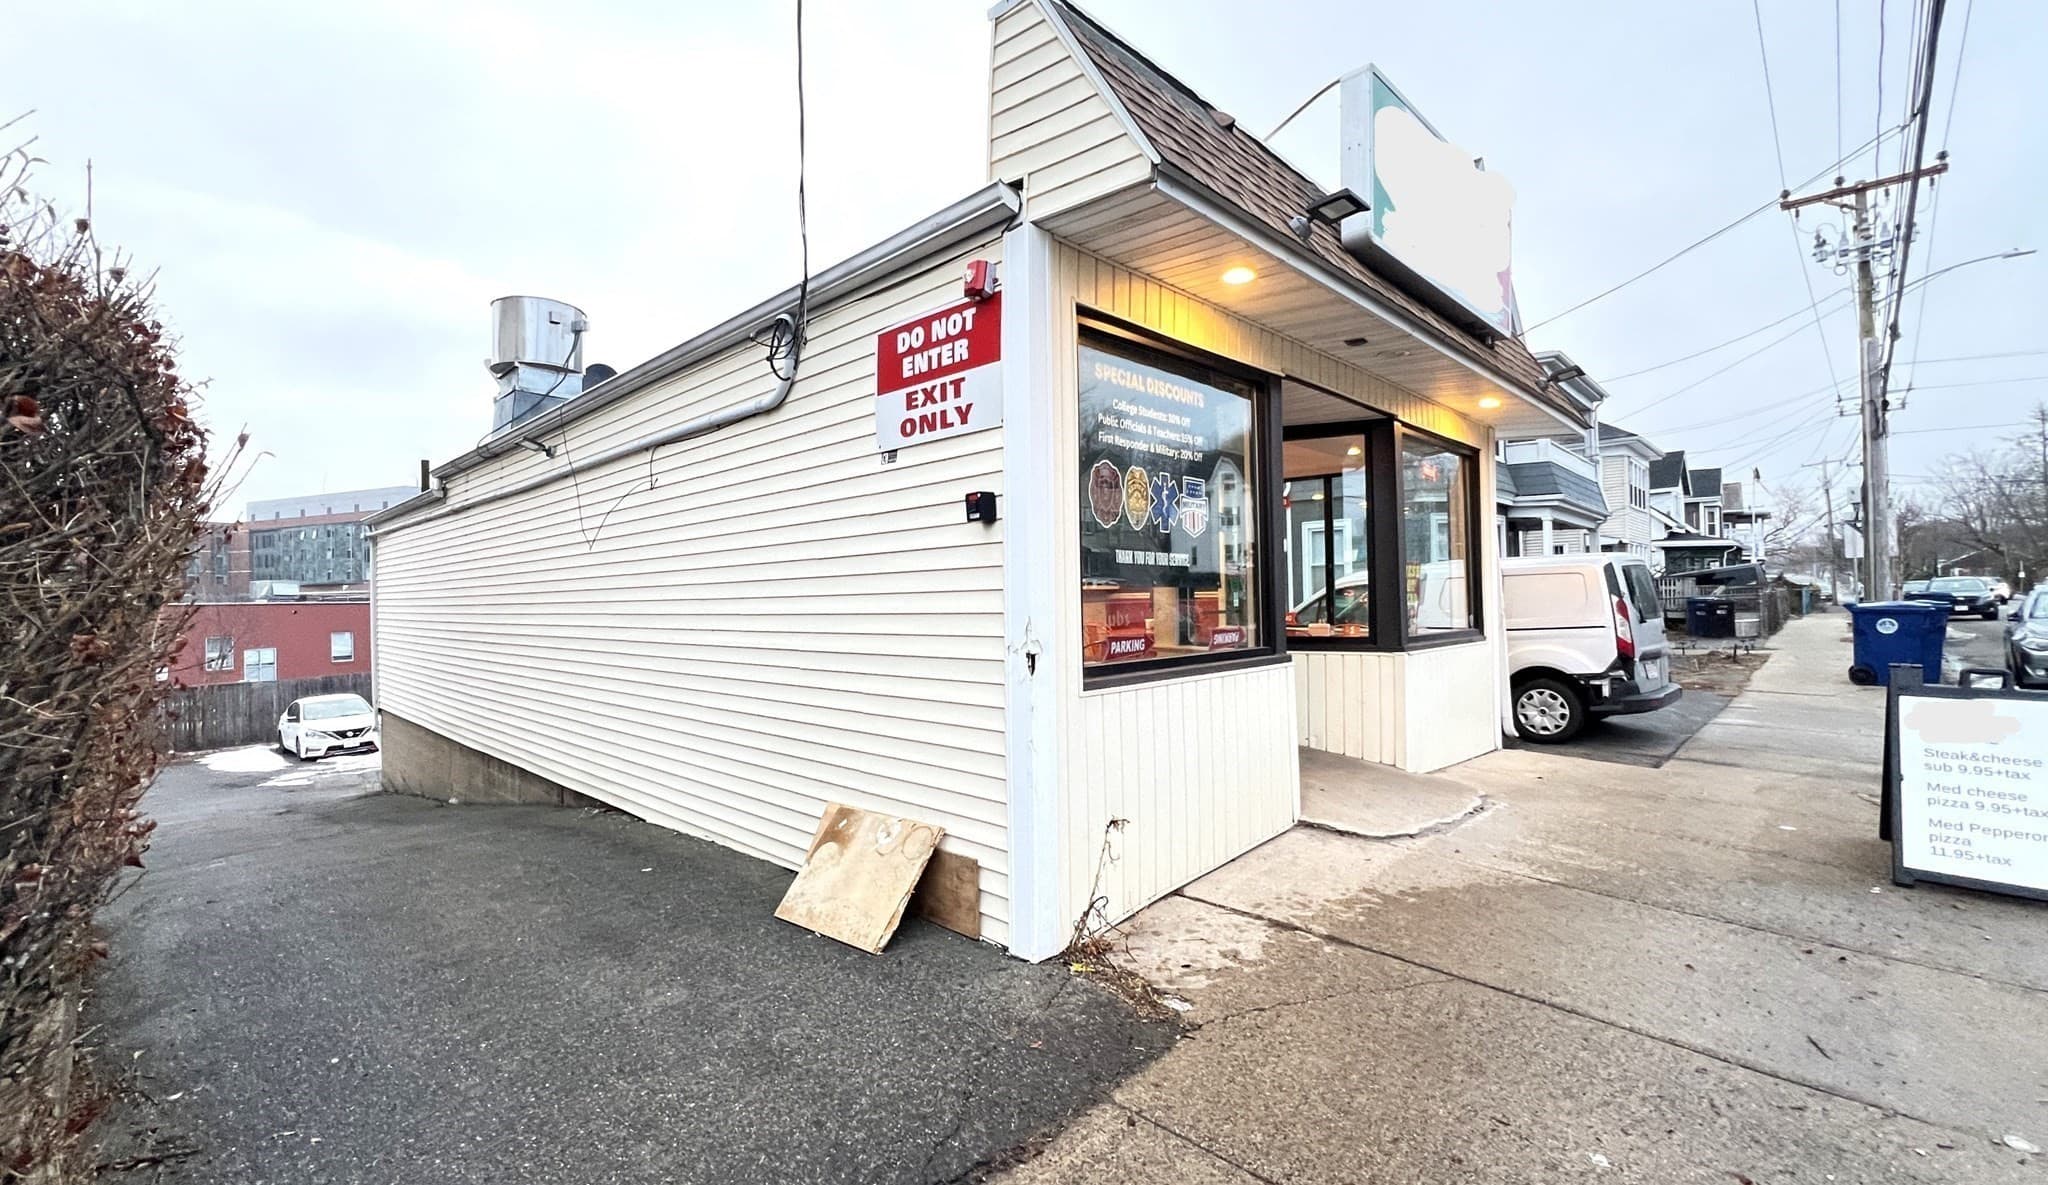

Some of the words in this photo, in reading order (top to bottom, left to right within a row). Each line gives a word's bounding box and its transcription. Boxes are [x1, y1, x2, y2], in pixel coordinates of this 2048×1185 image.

[897, 326, 925, 354] DO
[931, 306, 977, 342] NOT
[902, 338, 969, 379] ENTER
[905, 377, 966, 411] EXIT
[1095, 363, 1144, 392] SPECIAL
[1147, 378, 1204, 407] DISCOUNTS
[1113, 399, 1137, 415] College
[900, 403, 974, 438] ONLY
[1098, 413, 1118, 427] Public
[1120, 419, 1147, 434] Officials
[1099, 432, 1114, 444] First
[1115, 435, 1149, 452] Responder
[1110, 638, 1145, 655] PARKING
[1923, 747, 2043, 767] Steak&cheese
[1923, 762, 1953, 773] sub
[1958, 764, 2032, 780] 9.95+tax
[1927, 782, 1961, 795] Med
[1967, 787, 2028, 802] cheese
[1927, 796, 1969, 809] pizza
[1928, 818, 1964, 831] Med
[1929, 833, 1972, 847] pizza
[1930, 845, 2012, 866] 11.95+tax
